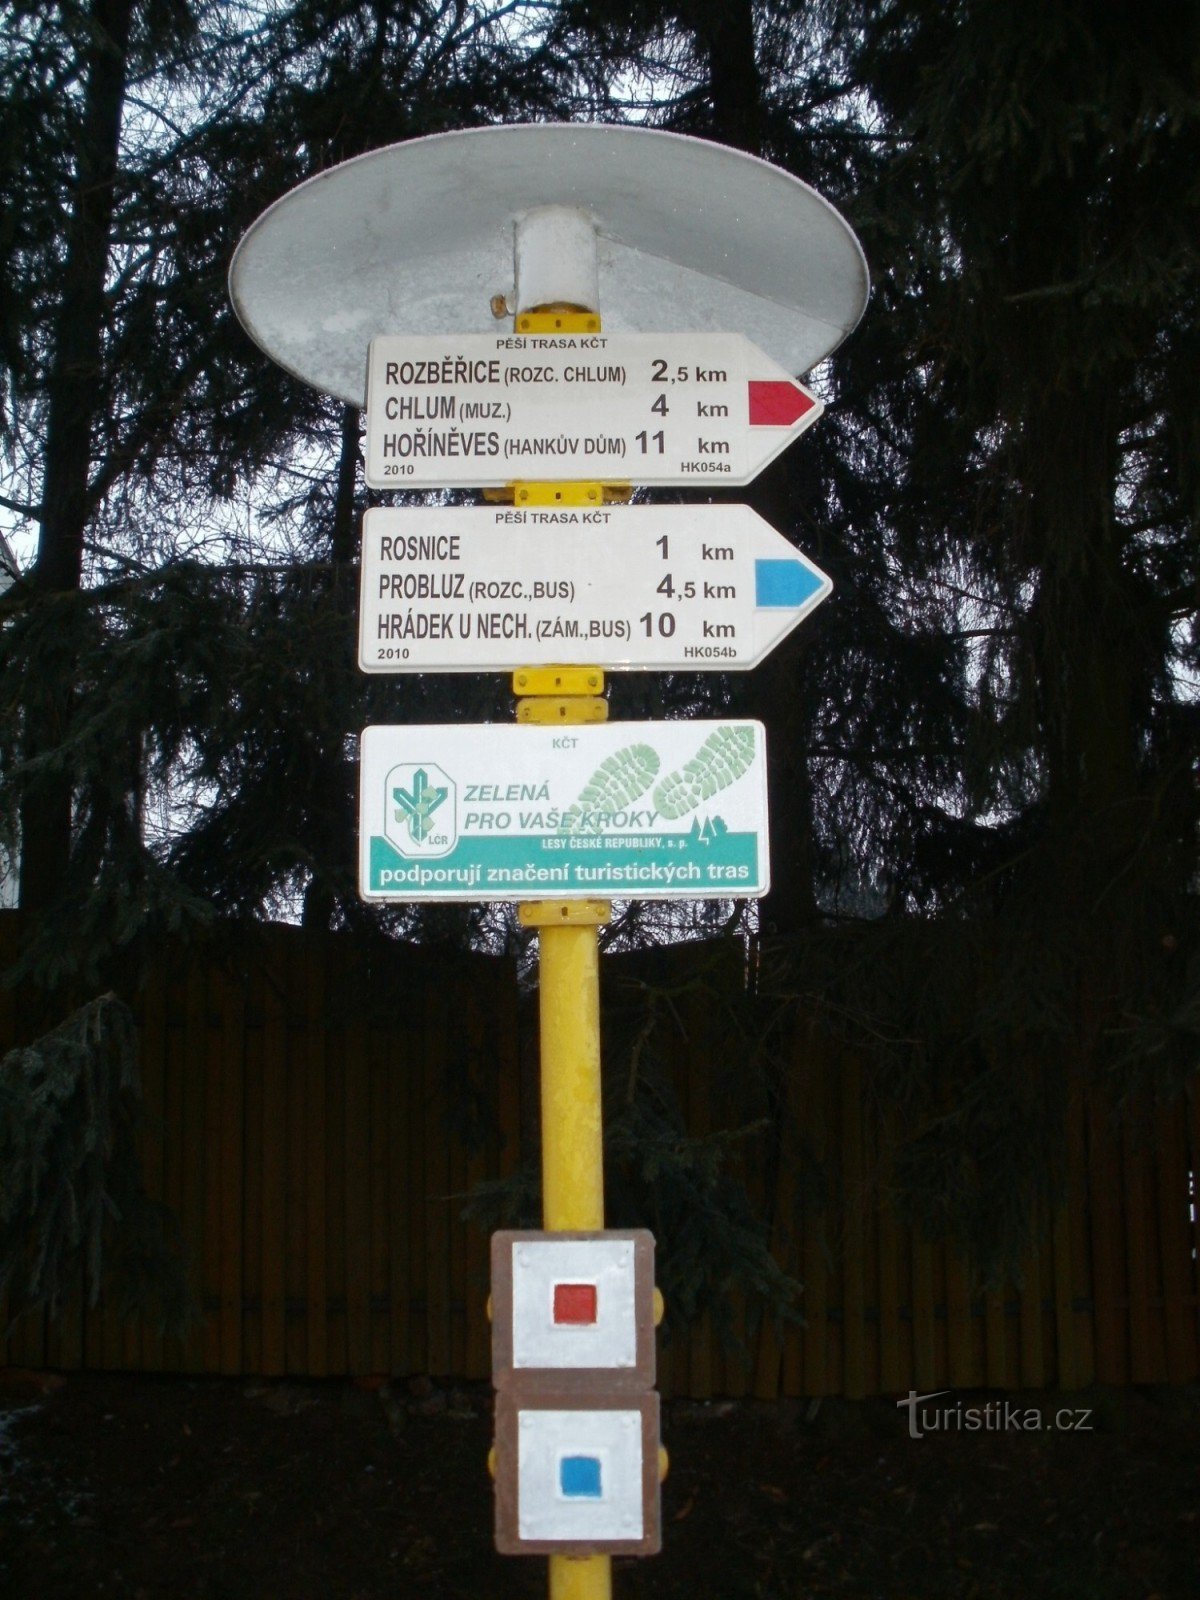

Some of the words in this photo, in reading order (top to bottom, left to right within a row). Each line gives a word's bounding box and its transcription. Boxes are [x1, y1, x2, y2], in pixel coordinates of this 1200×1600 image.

[496, 337, 527, 350] PĚŠÍ
[530, 339, 577, 349] TRASA
[579, 337, 608, 349] KČT
[386, 356, 500, 385] ROZBĚŘICE
[504, 366, 559, 386] (ROZC.
[563, 365, 627, 385] CHLUM)
[651, 359, 689, 385] 2,5
[696, 367, 727, 382] km
[385, 396, 455, 420] CHLUM
[459, 403, 511, 421] (MUZ.)
[650, 394, 670, 417] 4
[698, 402, 729, 417] km
[383, 427, 500, 457] HOŘÍNĚVES
[504, 435, 579, 458] (HANKŮV
[584, 434, 627, 458] DŮM)
[635, 431, 665, 454] 11
[698, 438, 730, 453] km
[384, 465, 414, 475] 2010
[681, 462, 731, 473] HK054a
[495, 511, 527, 524] PĚŠÍ
[530, 513, 579, 524] TRASA
[582, 511, 611, 524] KČT
[380, 535, 460, 561] ROSNICE
[655, 535, 670, 559] 1
[702, 545, 734, 560] km
[379, 573, 464, 599] PROBLUZ
[656, 574, 696, 602] 4,5
[704, 583, 736, 599] km
[377, 608, 454, 639] HRÁDEK
[459, 614, 471, 639] U
[477, 613, 532, 639] NECH.
[639, 613, 676, 638] 10
[704, 621, 736, 637] km
[377, 648, 410, 659] 2010
[684, 646, 737, 658] HK054b
[552, 737, 578, 749] KČT
[464, 780, 550, 802] ZELENÁ
[464, 812, 511, 830] PRO
[519, 808, 572, 828] VAŠE
[581, 811, 659, 828] KROKY
[542, 838, 567, 849] LESY
[570, 836, 602, 849] ČESKÉ
[604, 837, 665, 850] REPUBLIKY,
[381, 865, 481, 885] podporují
[488, 862, 570, 881] značení
[575, 861, 700, 882] turistických
[707, 864, 749, 879] tras
